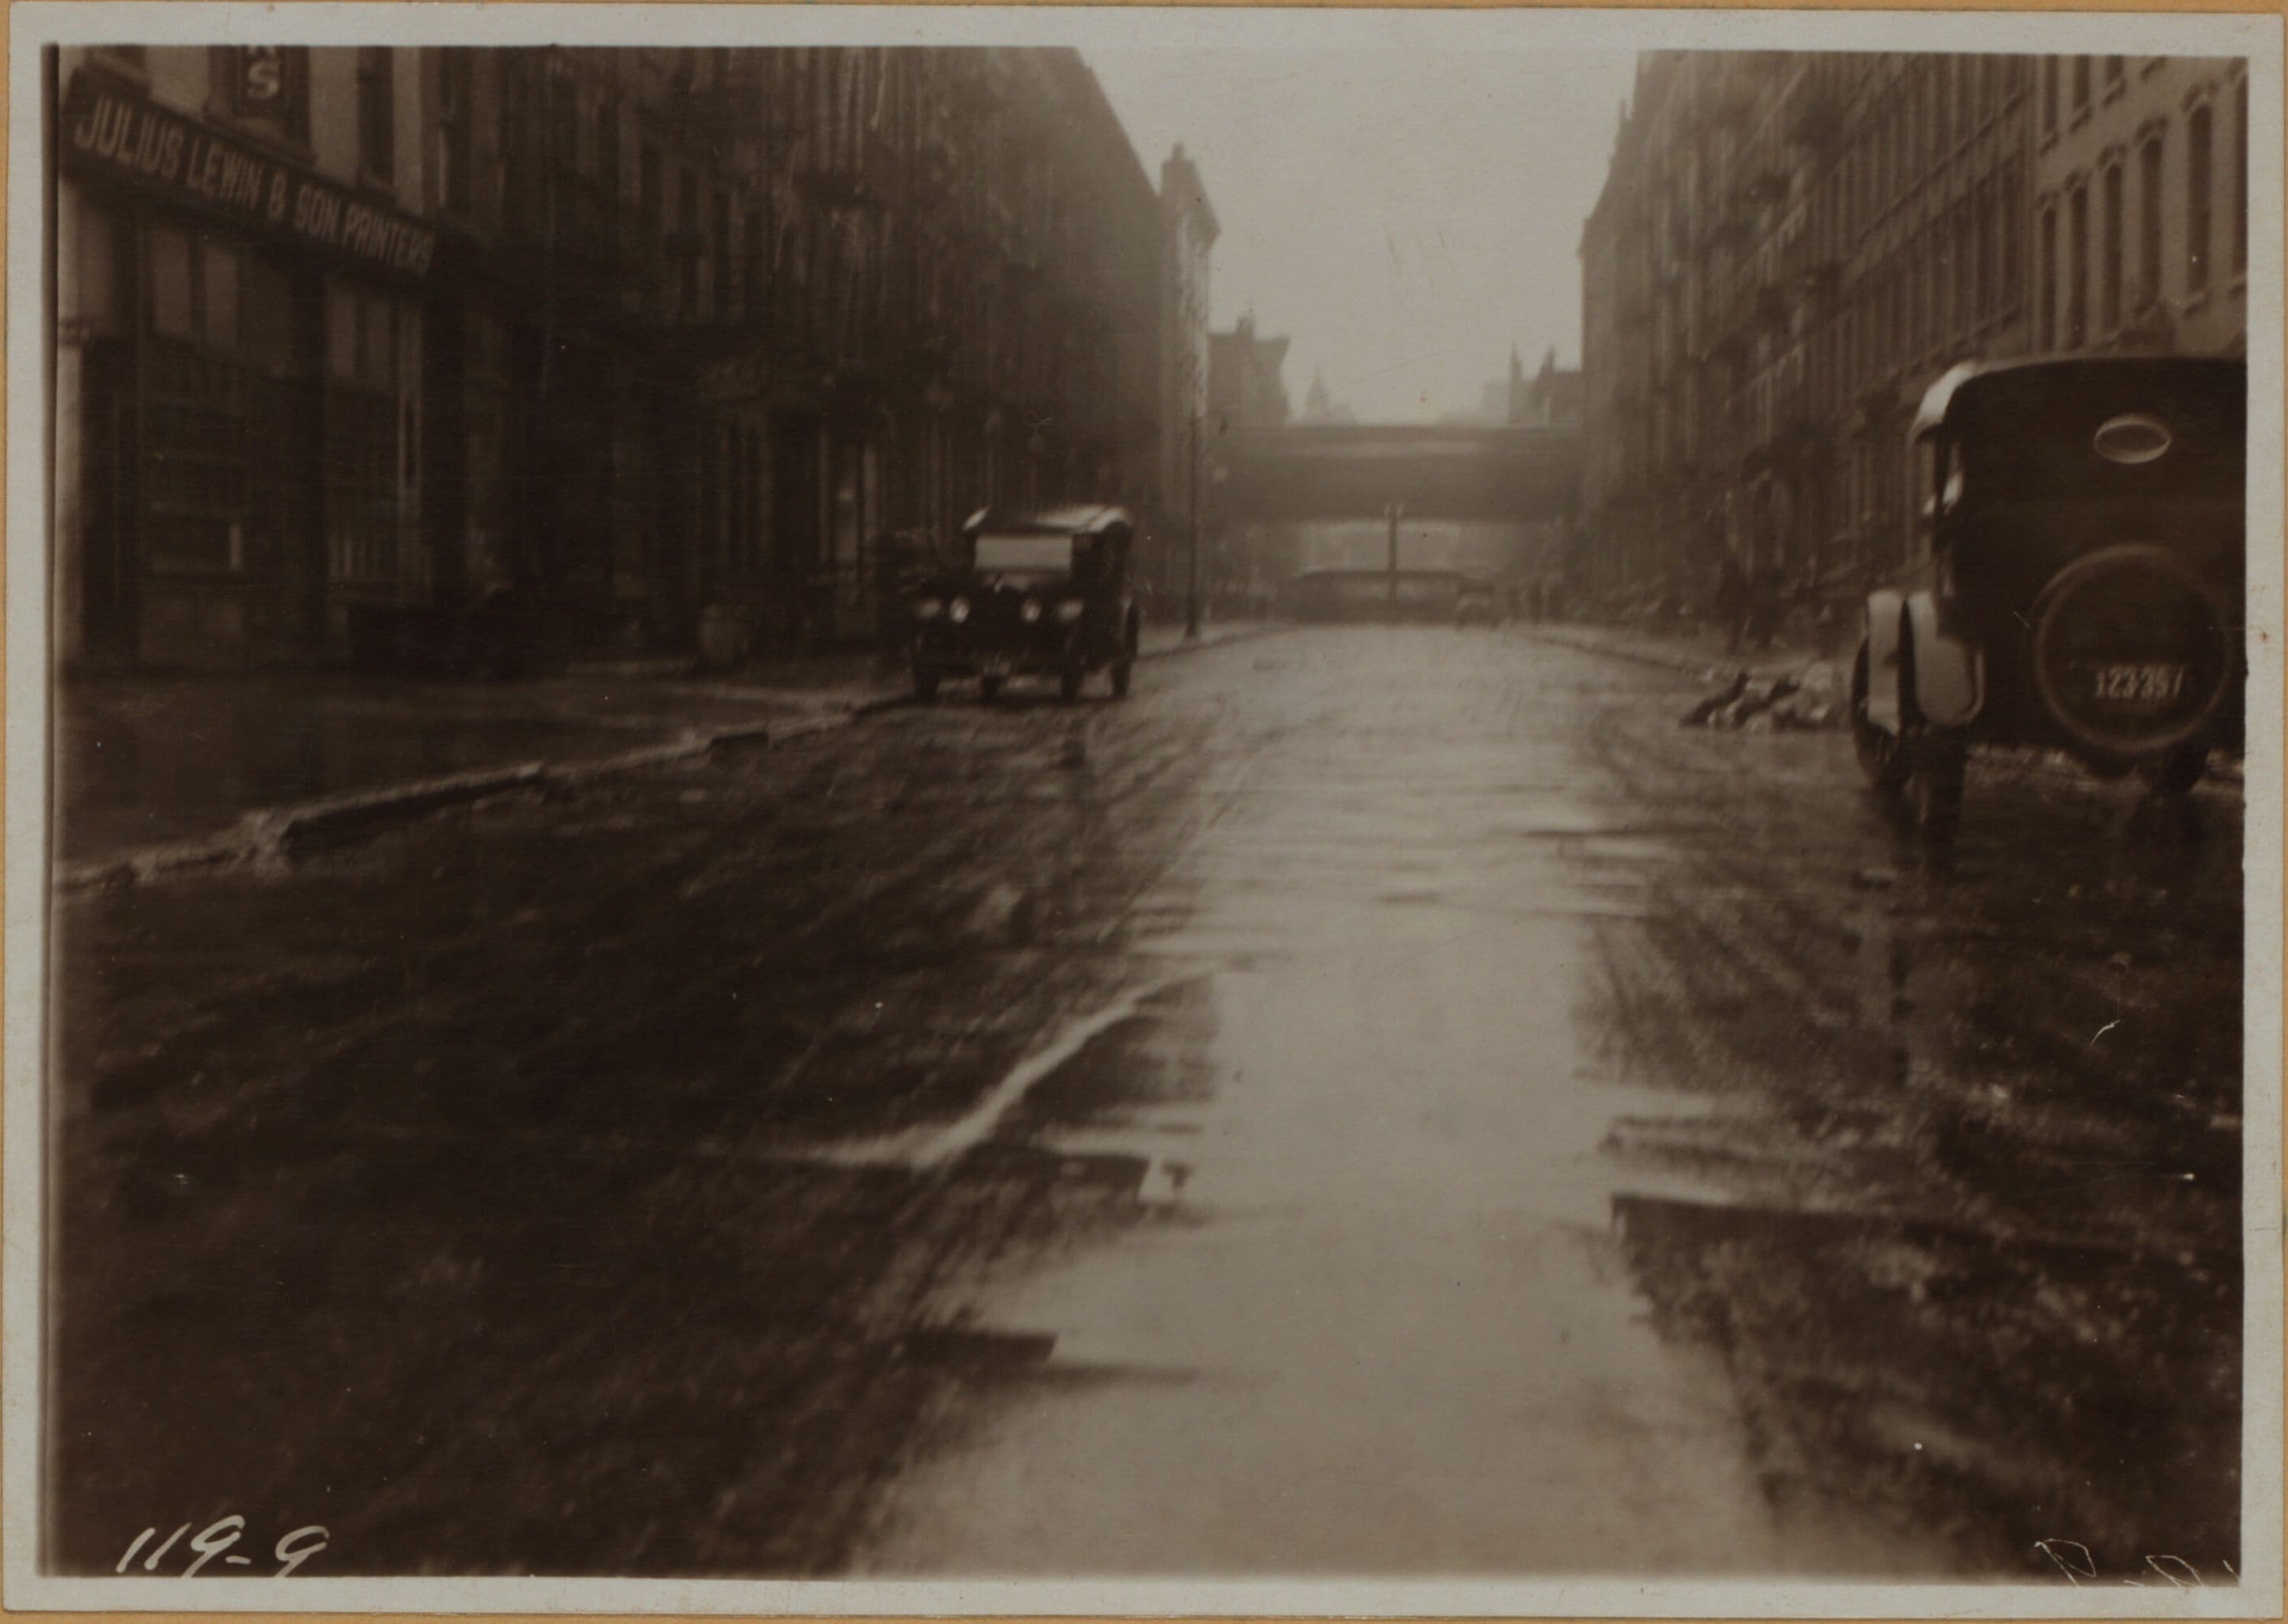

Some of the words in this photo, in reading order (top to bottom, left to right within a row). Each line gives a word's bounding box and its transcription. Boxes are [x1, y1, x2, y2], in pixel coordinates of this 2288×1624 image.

[75, 93, 185, 179] JULIUS
[294, 183, 342, 244] SON
[341, 201, 435, 276] PRINTERS
